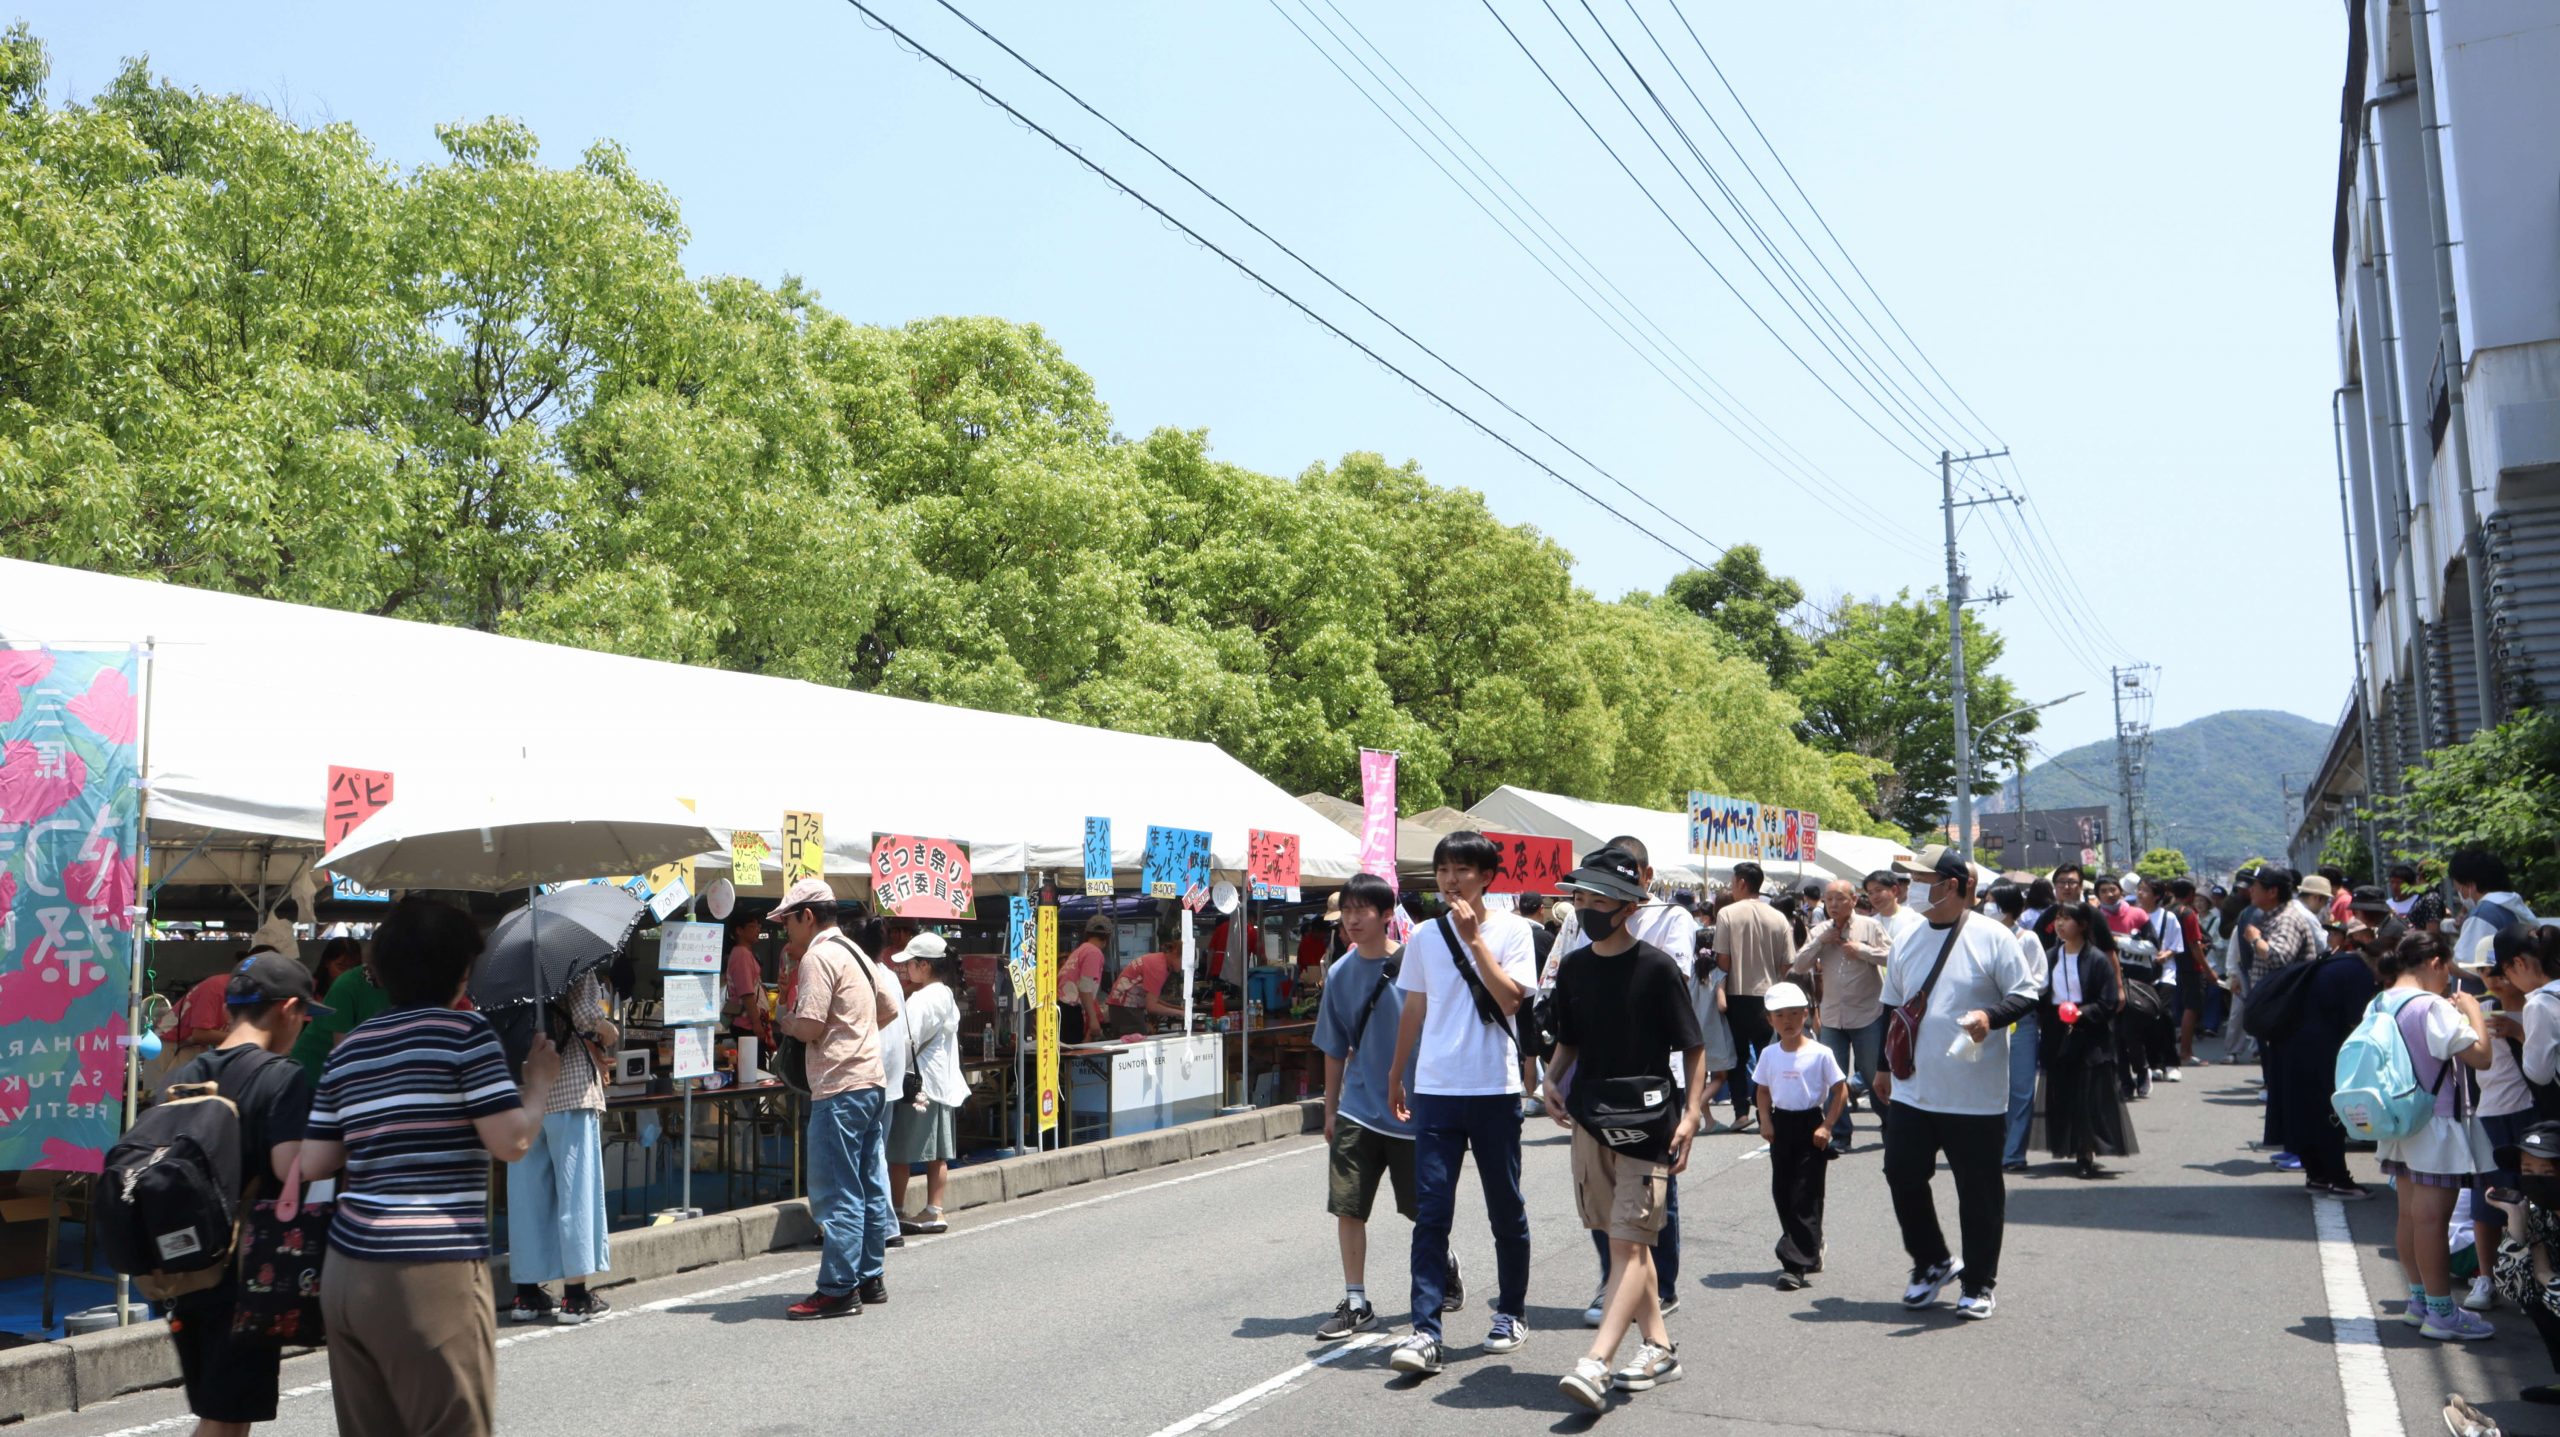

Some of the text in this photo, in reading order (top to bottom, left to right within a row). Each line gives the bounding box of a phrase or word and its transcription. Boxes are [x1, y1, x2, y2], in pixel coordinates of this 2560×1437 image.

[1086, 817, 1097, 878] 生ビール
[1099, 820, 1109, 876] ハイボール
[1785, 812, 1799, 859] 氷
[877, 843, 962, 882] さつき祭り
[877, 872, 966, 910] 実行委員会
[1012, 899, 1024, 958] チューハイ
